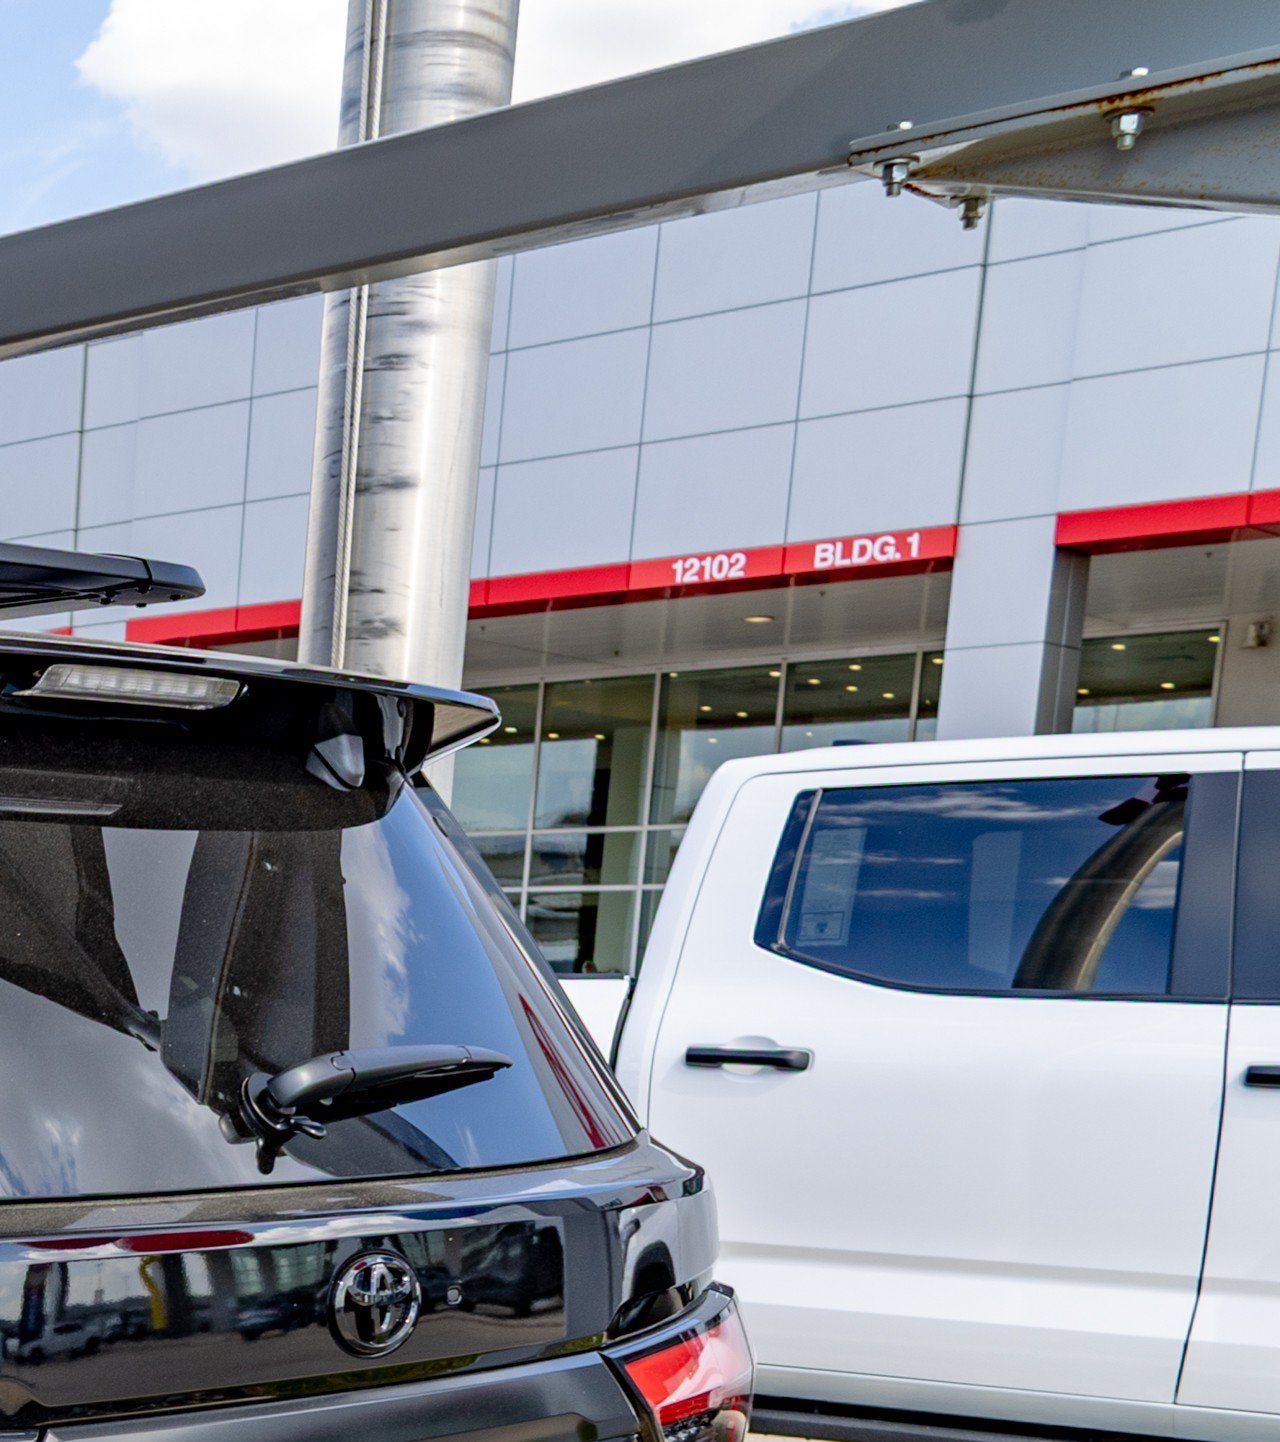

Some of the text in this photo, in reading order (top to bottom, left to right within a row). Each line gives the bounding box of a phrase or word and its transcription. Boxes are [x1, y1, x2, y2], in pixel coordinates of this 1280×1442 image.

[814, 532, 921, 569] BLDG. 1
[672, 553, 747, 583] 12102
